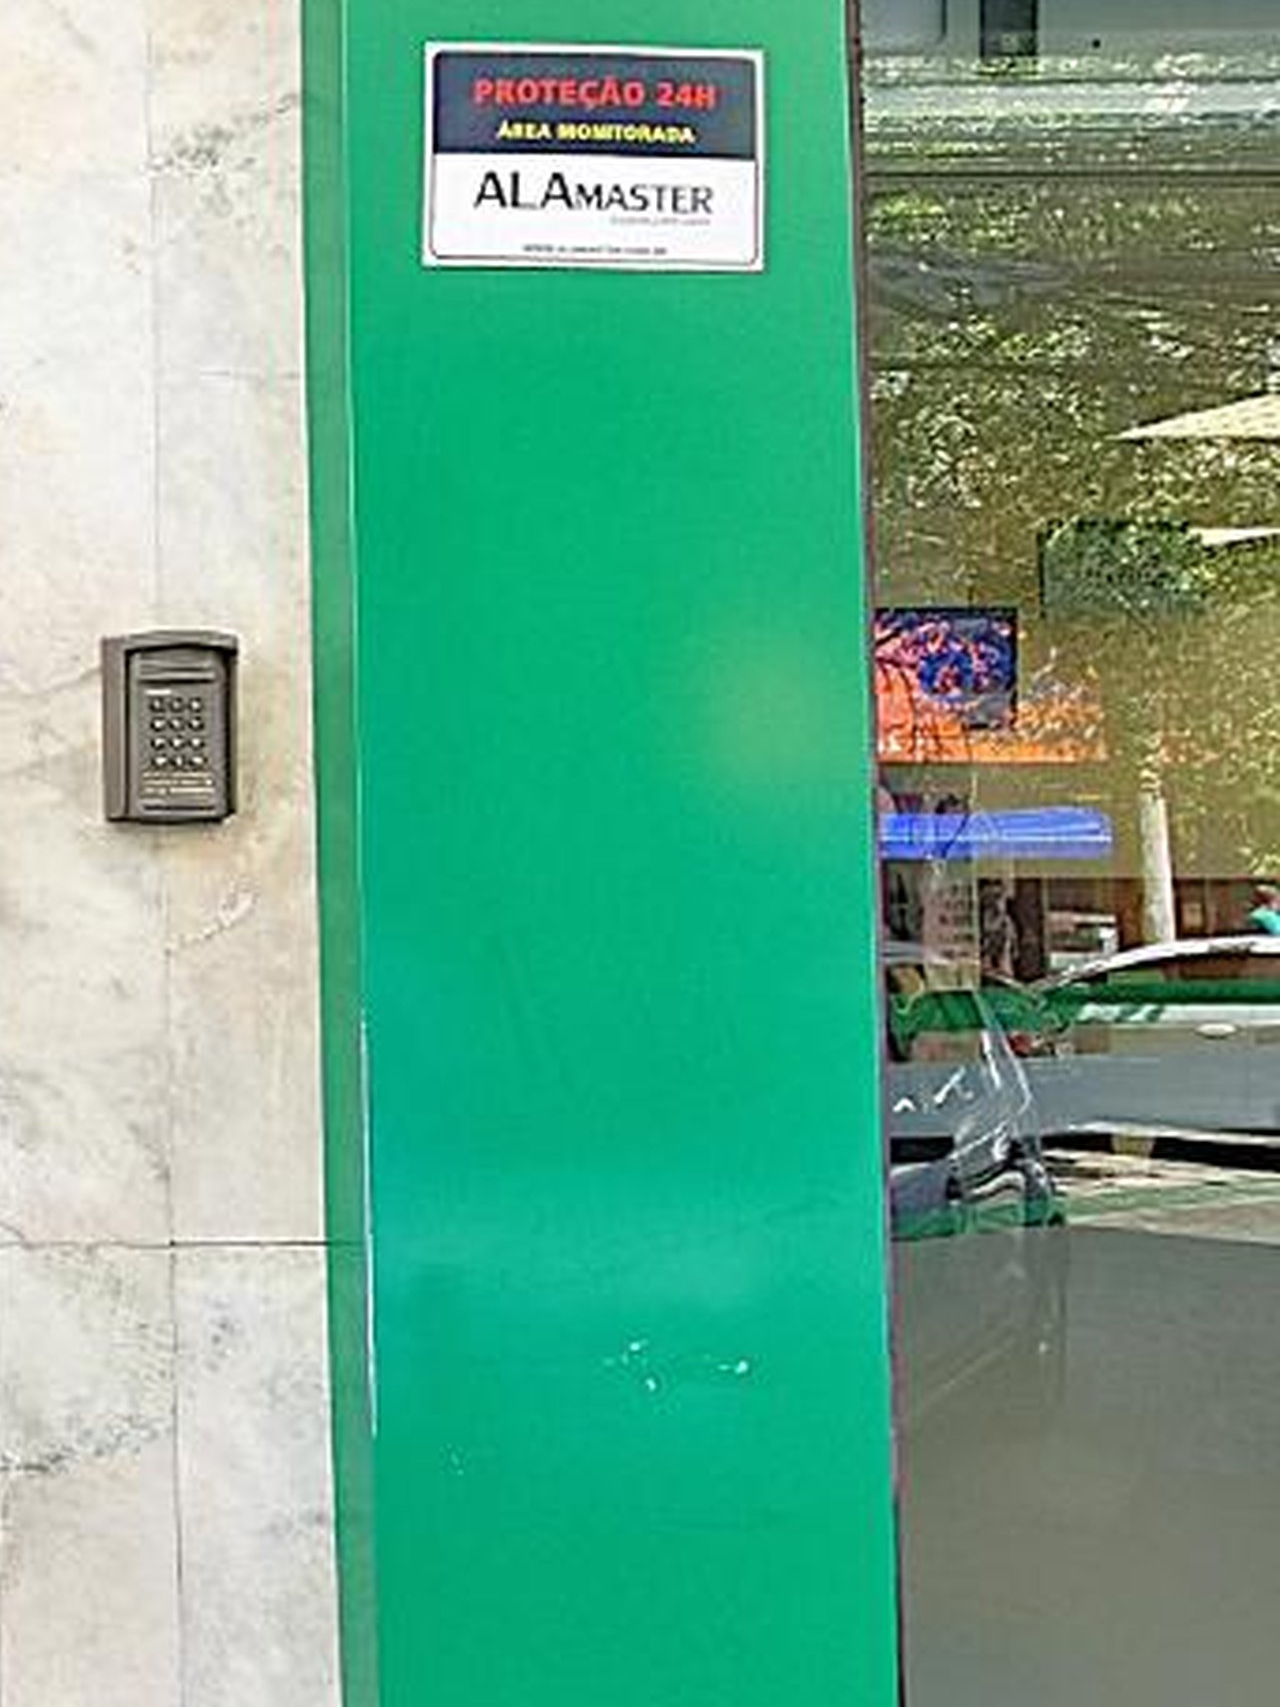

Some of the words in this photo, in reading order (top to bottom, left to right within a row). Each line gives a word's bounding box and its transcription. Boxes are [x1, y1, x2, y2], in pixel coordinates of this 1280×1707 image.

[473, 76, 645, 111] PROTEÇÃO
[655, 83, 719, 110] 24H
[556, 122, 696, 144] MONITORADA
